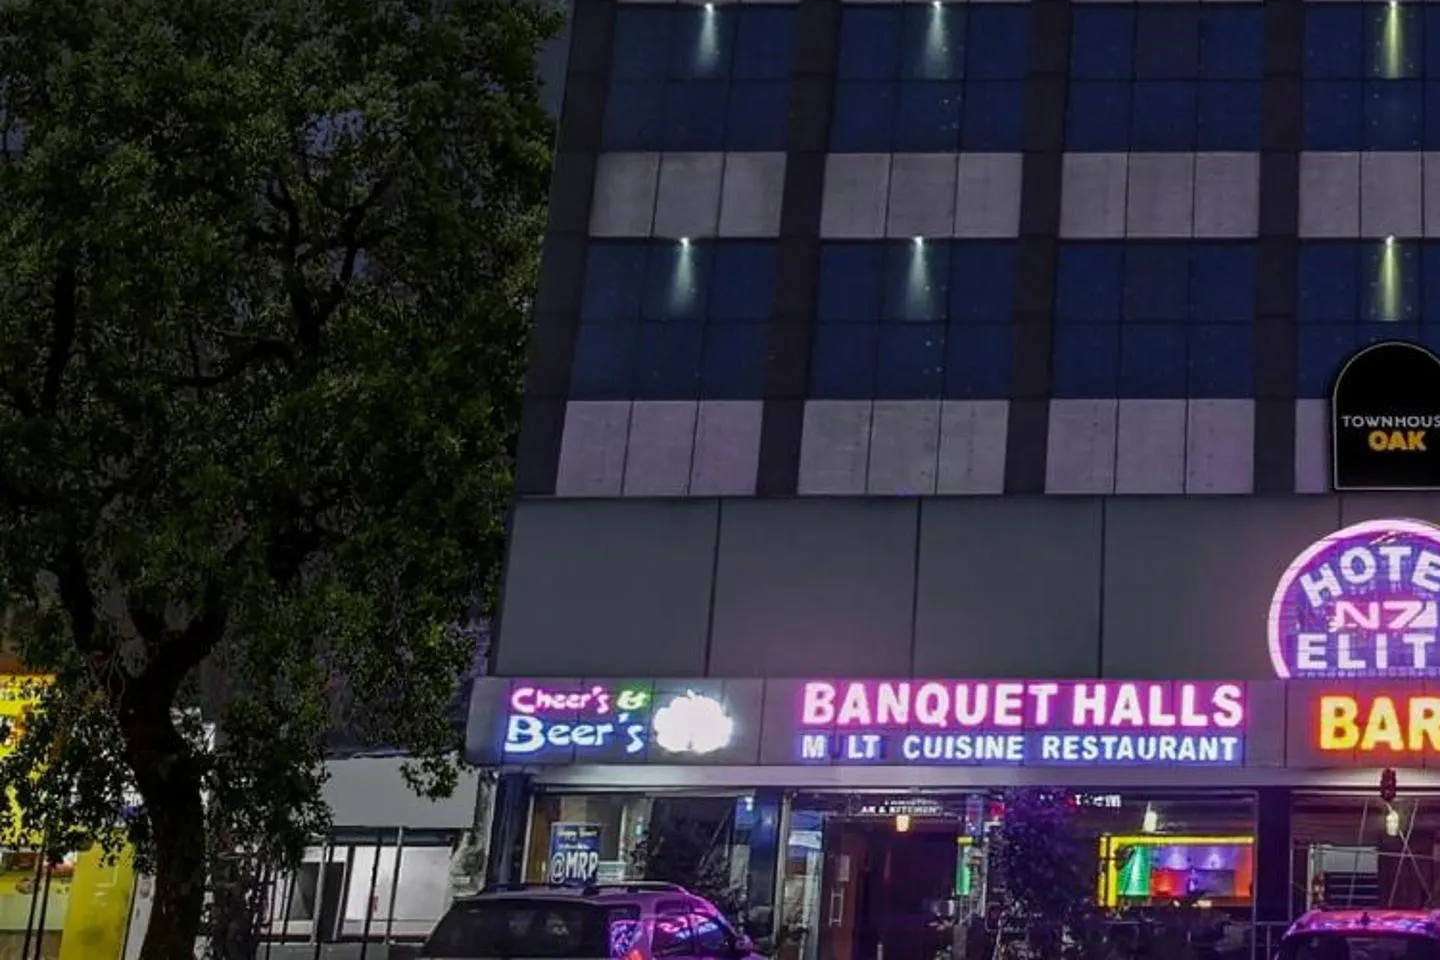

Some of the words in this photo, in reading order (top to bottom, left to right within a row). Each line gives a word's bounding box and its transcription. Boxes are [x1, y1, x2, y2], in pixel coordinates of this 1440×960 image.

[1367, 430, 1427, 451] OAK
[511, 686, 609, 714] Cheer's
[617, 691, 648, 710] &
[803, 682, 1058, 728] BANQUET
[1072, 684, 1243, 727] HALLS
[504, 713, 644, 753] Beer's
[902, 735, 1025, 760] CUISINE
[1042, 735, 1238, 761] RESTAURANT
